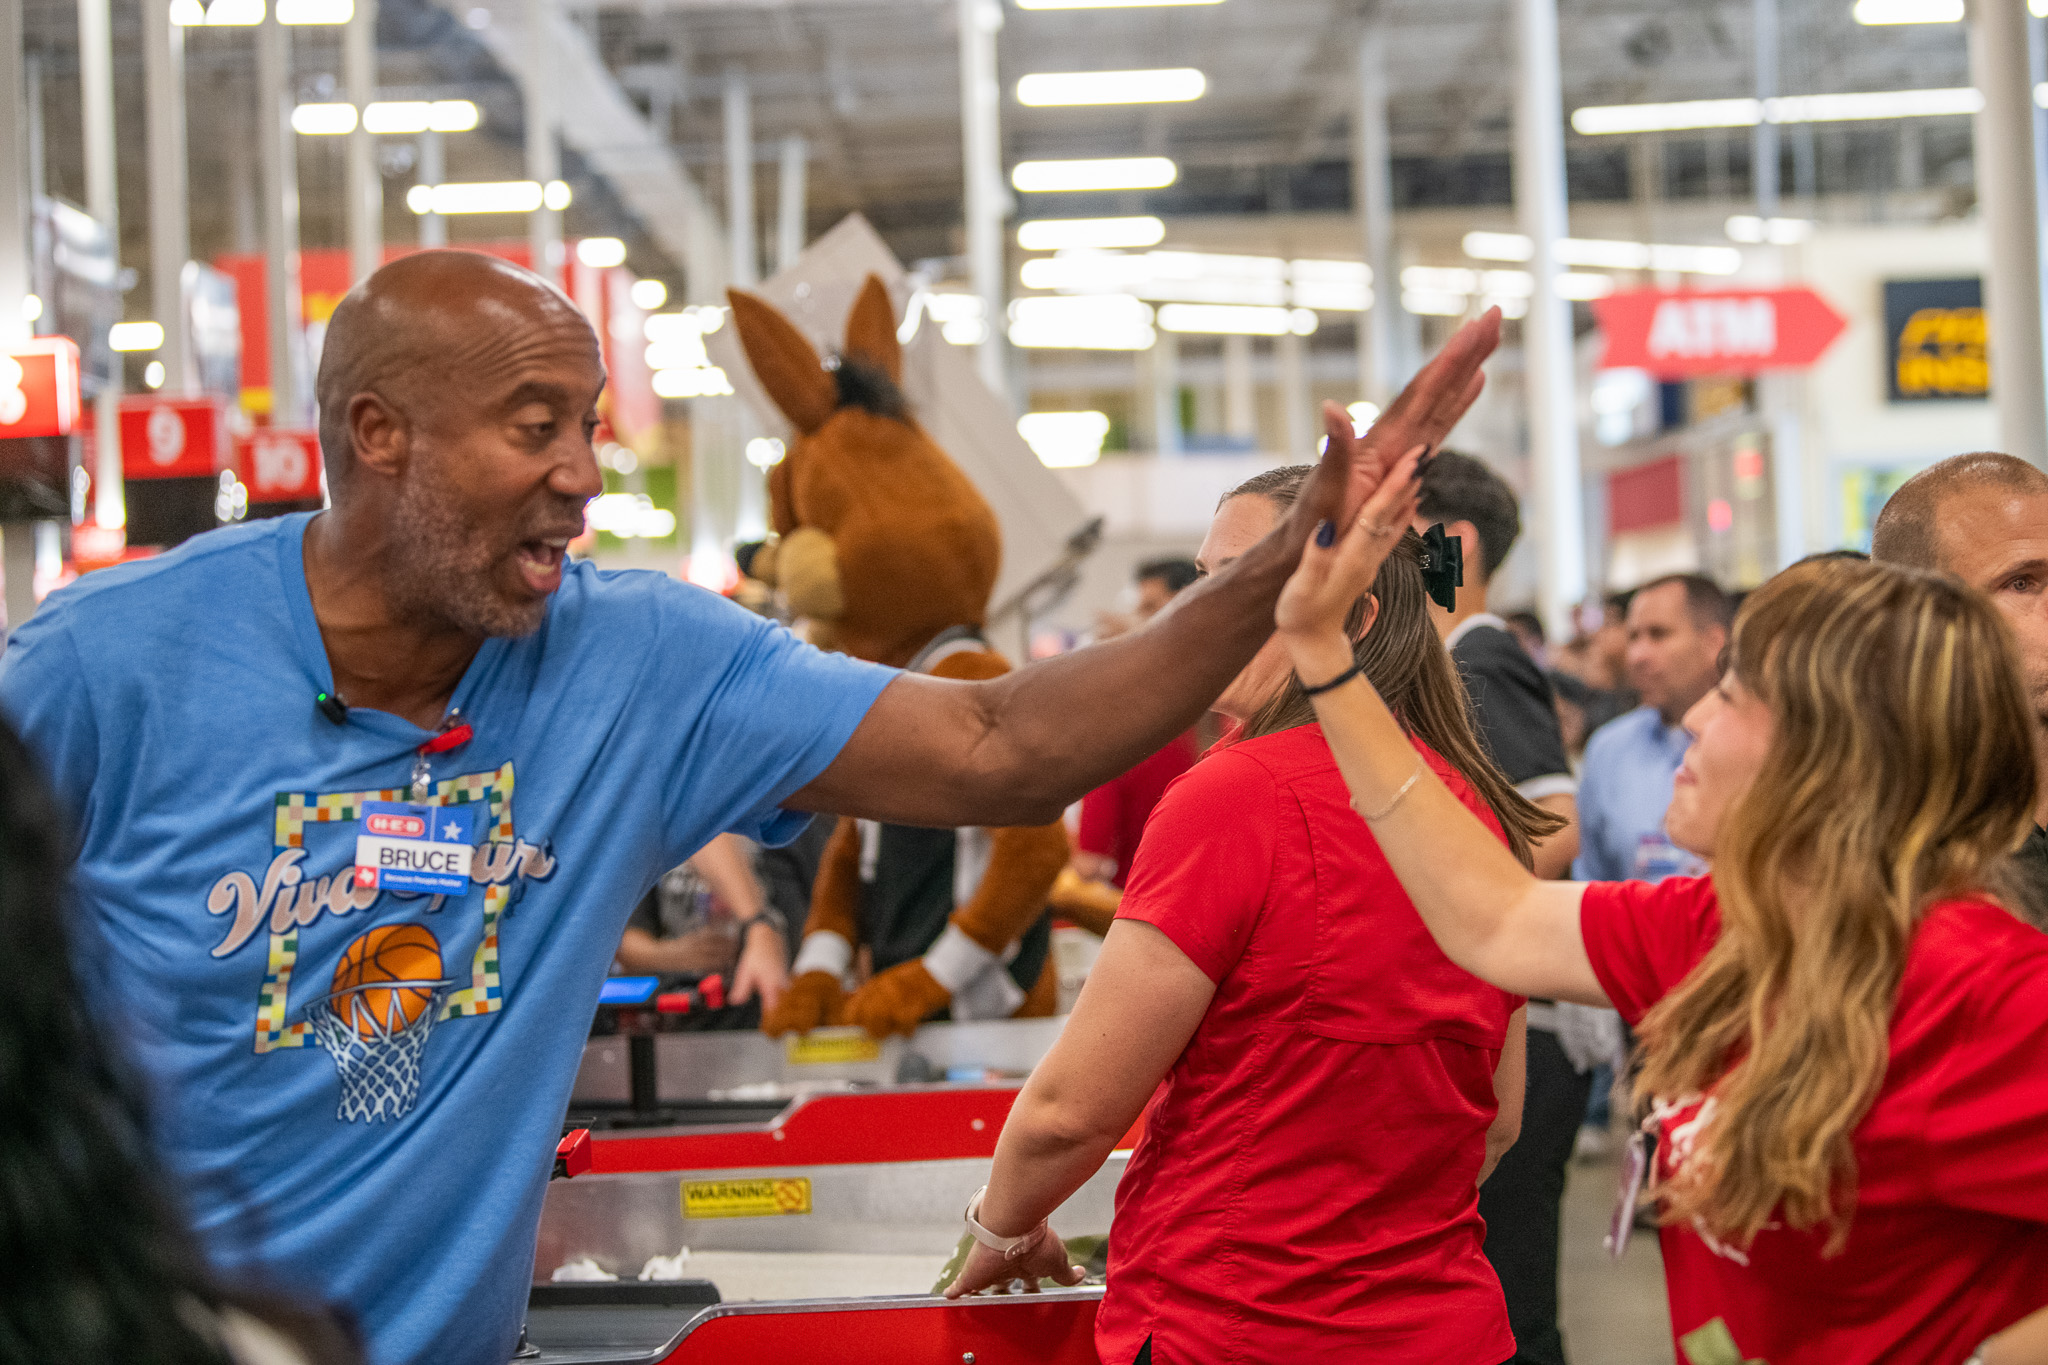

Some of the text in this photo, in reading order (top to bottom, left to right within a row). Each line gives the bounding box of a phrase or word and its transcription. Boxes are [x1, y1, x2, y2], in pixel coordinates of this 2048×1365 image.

[1647, 298, 1778, 359] ATM
[147, 405, 185, 466] 9
[252, 437, 309, 492] 10
[379, 847, 460, 872] BRUCE
[207, 847, 380, 958] Viva
[688, 1181, 774, 1200] WARNING
